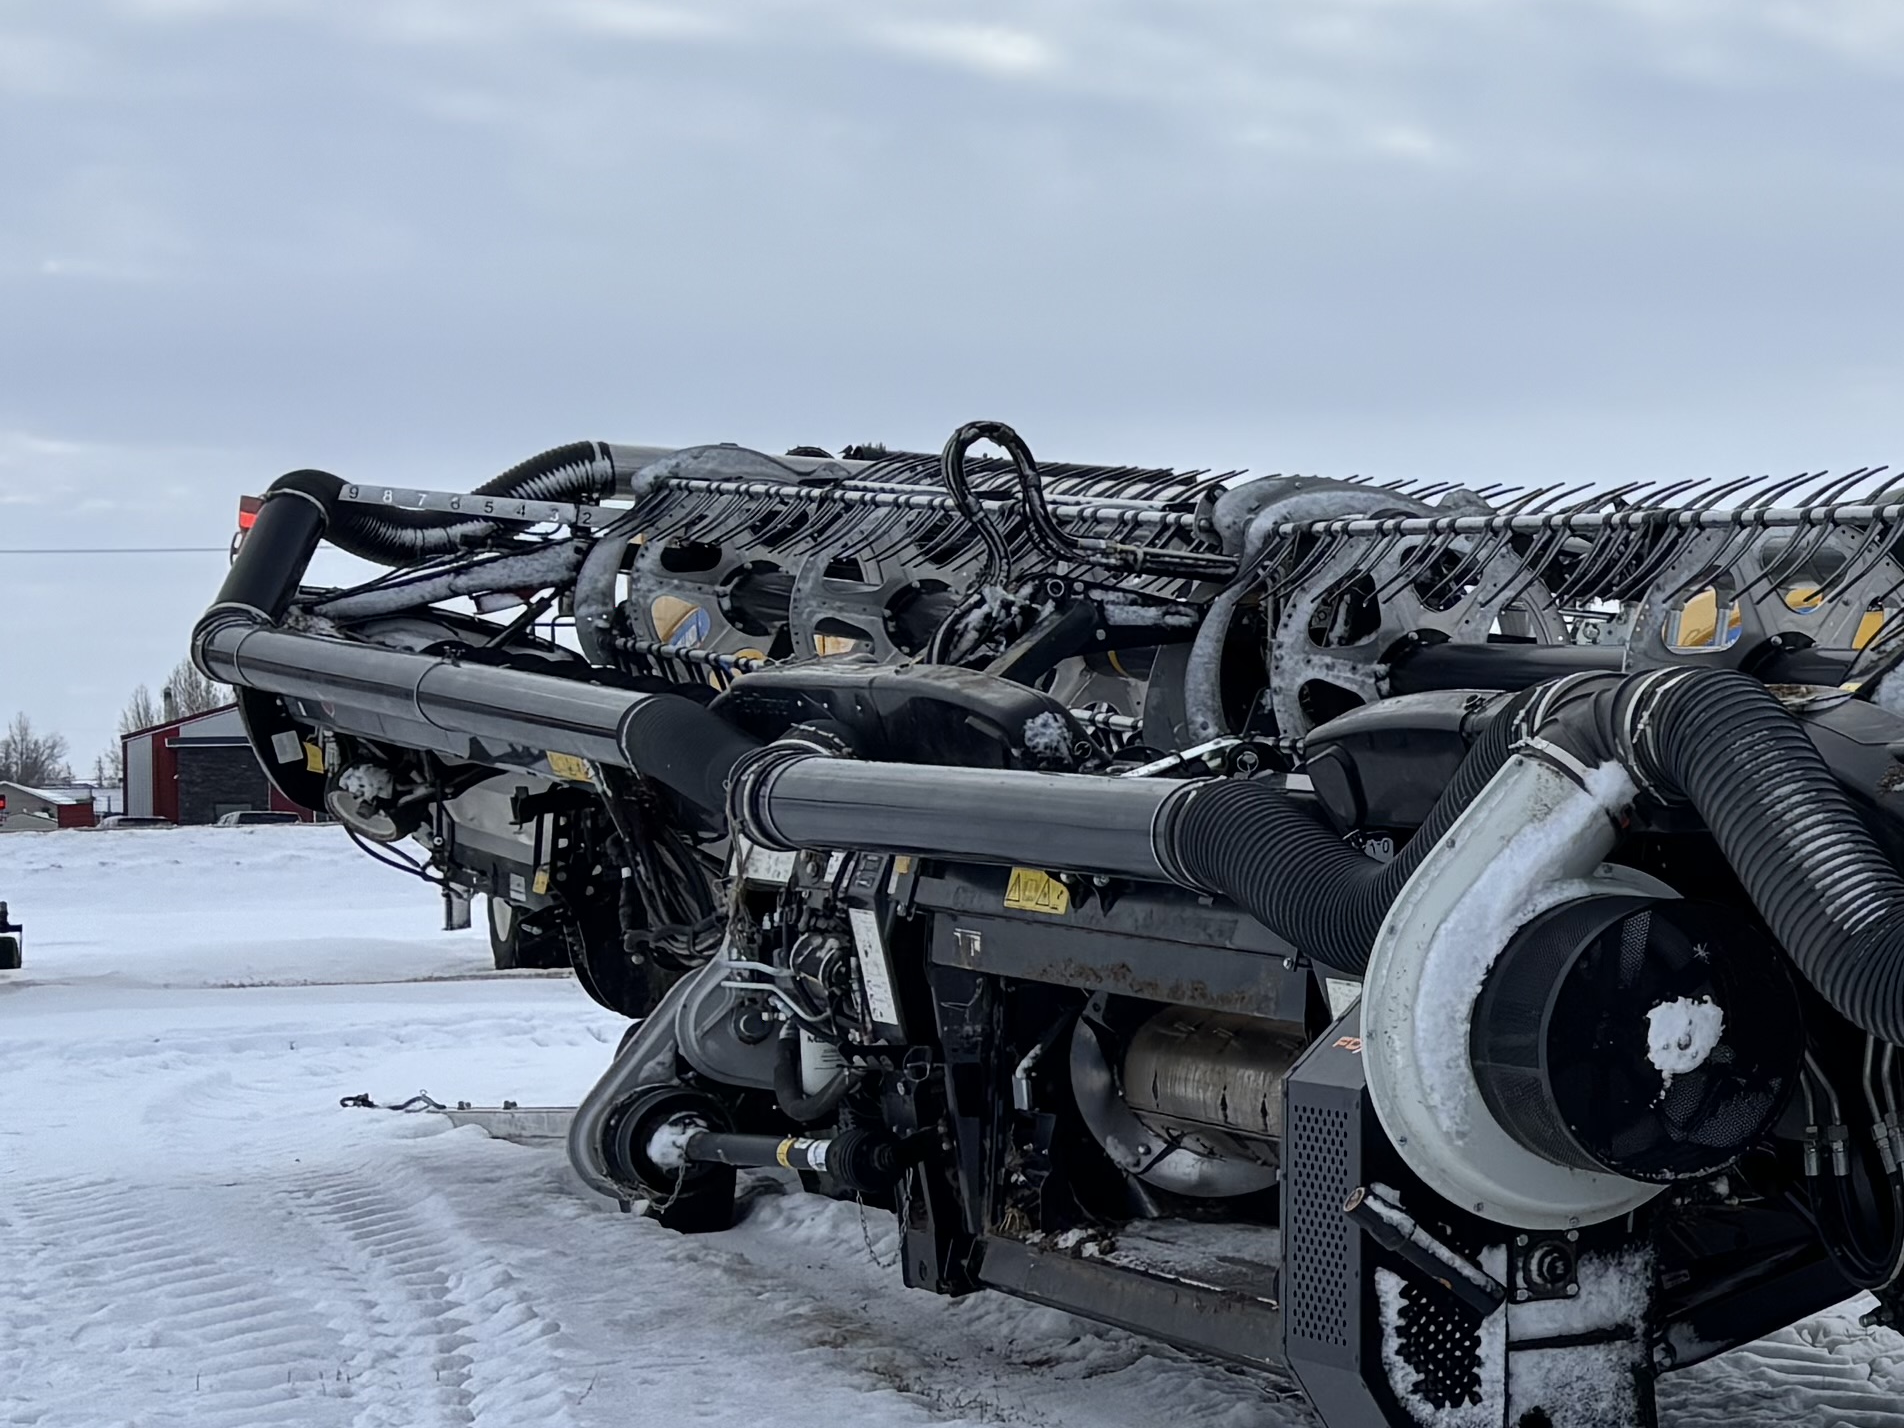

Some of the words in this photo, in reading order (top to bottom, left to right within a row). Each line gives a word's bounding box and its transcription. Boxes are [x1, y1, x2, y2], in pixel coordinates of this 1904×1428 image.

[348, 485, 359, 499] 9
[382, 489, 393, 503] 8
[418, 493, 427, 506] 7
[450, 496, 460, 510] 6
[484, 500, 494, 513] 5
[516, 504, 526, 517] 4
[582, 512, 592, 524] 2
